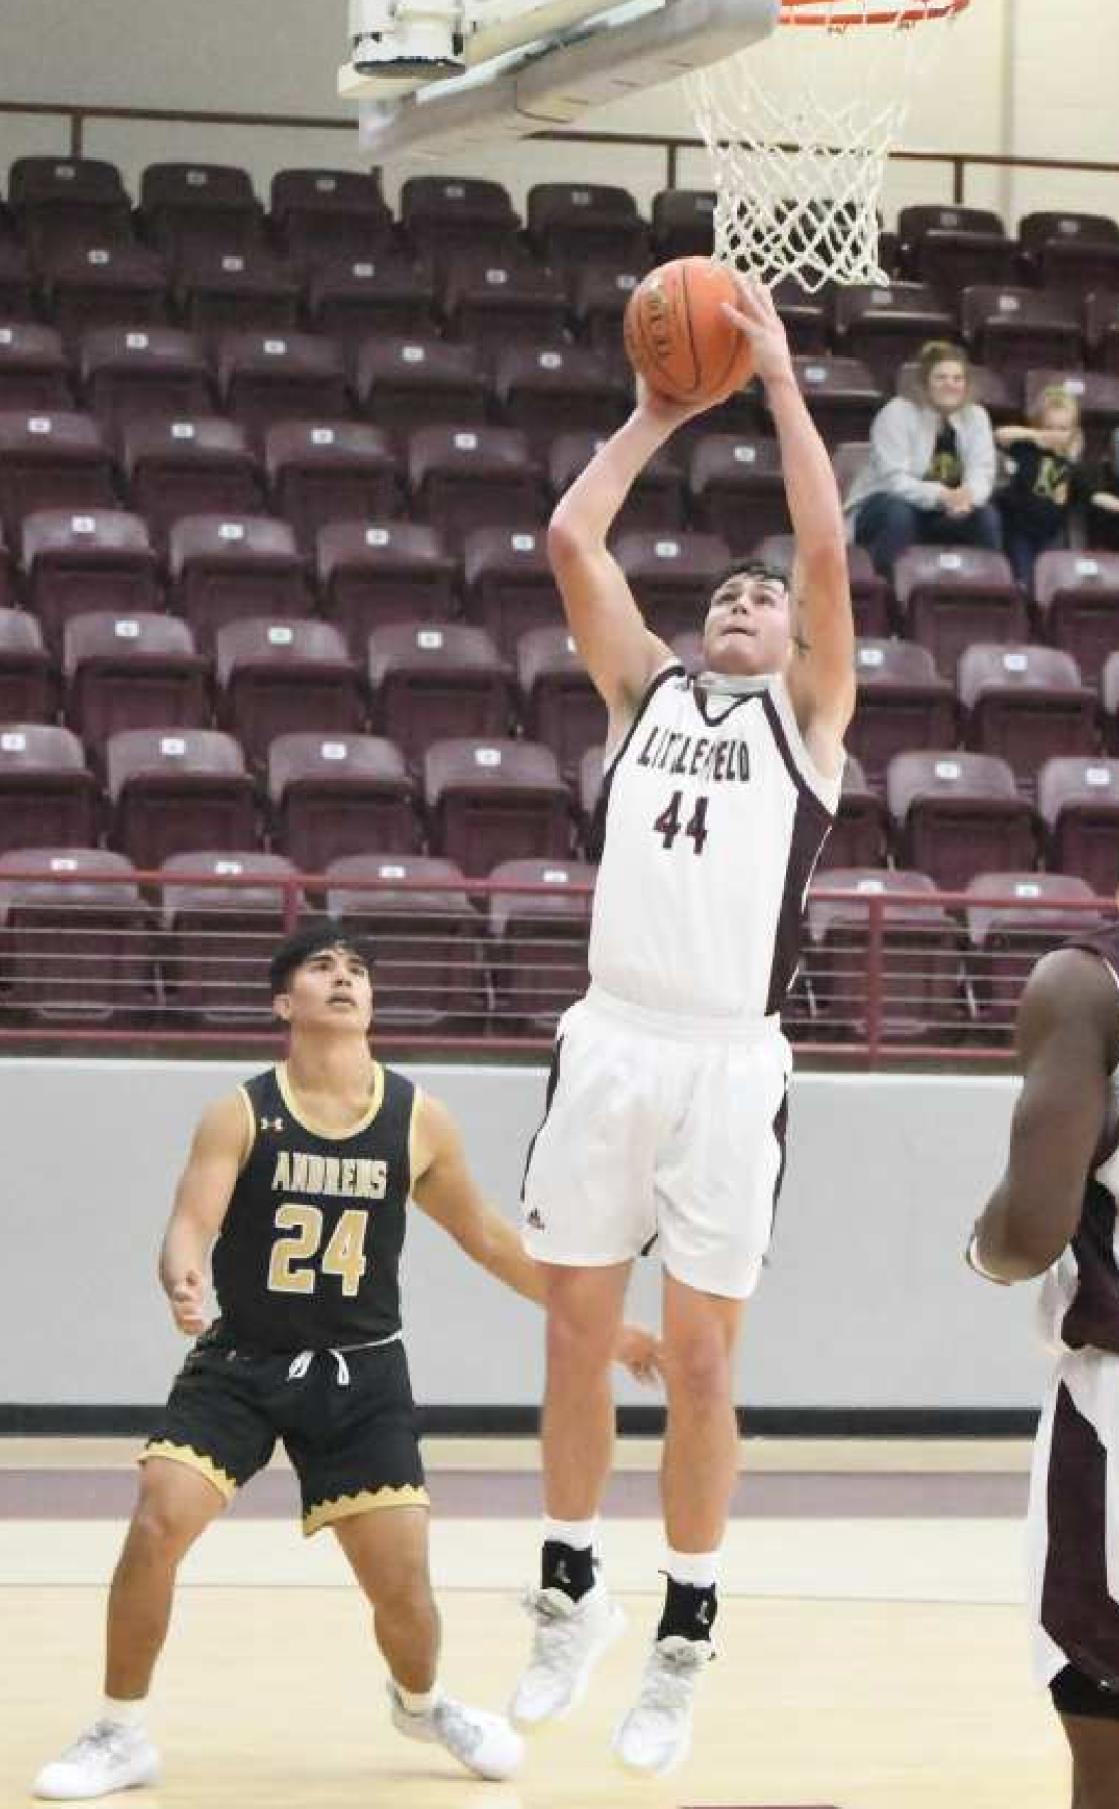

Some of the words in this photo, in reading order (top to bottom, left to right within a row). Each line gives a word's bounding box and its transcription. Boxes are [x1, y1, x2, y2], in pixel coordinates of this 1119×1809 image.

[653, 790, 708, 855] 44
[271, 1151, 388, 1200] ANDREWS
[266, 1203, 369, 1297] 24
